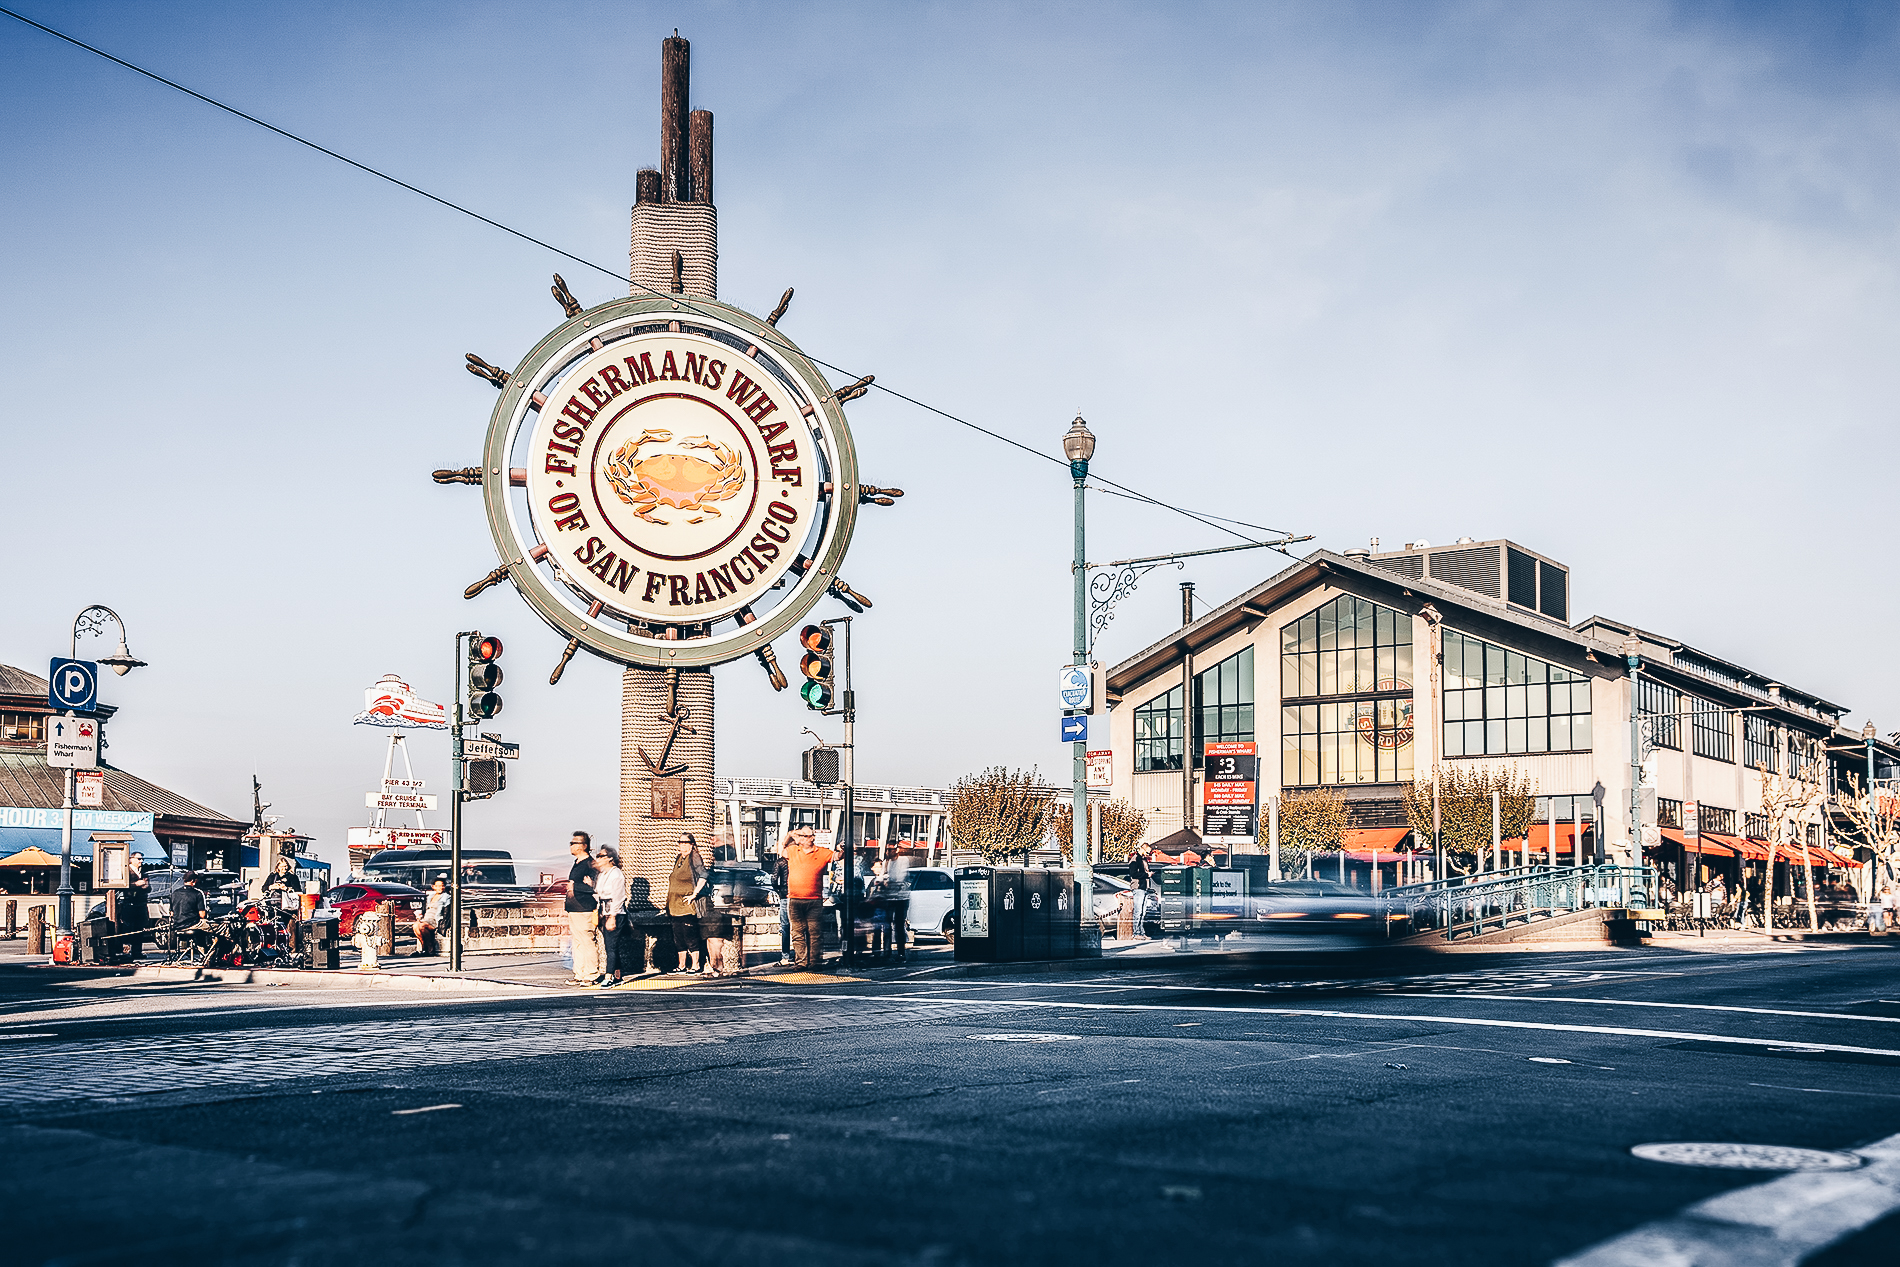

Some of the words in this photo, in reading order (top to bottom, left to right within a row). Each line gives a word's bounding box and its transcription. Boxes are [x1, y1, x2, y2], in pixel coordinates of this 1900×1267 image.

[545, 350, 727, 477] FISHERMANS
[726, 369, 802, 487] WHARF
[548, 492, 590, 532] OF
[573, 536, 640, 594] SAN
[641, 500, 798, 606] FRANCISCO
[54, 742, 92, 752] Fisherman's
[468, 743, 515, 756] Jefferson
[1220, 757, 1235, 773] $3
[0, 808, 47, 826] HOUR
[95, 812, 150, 825] WEEKDAYS
